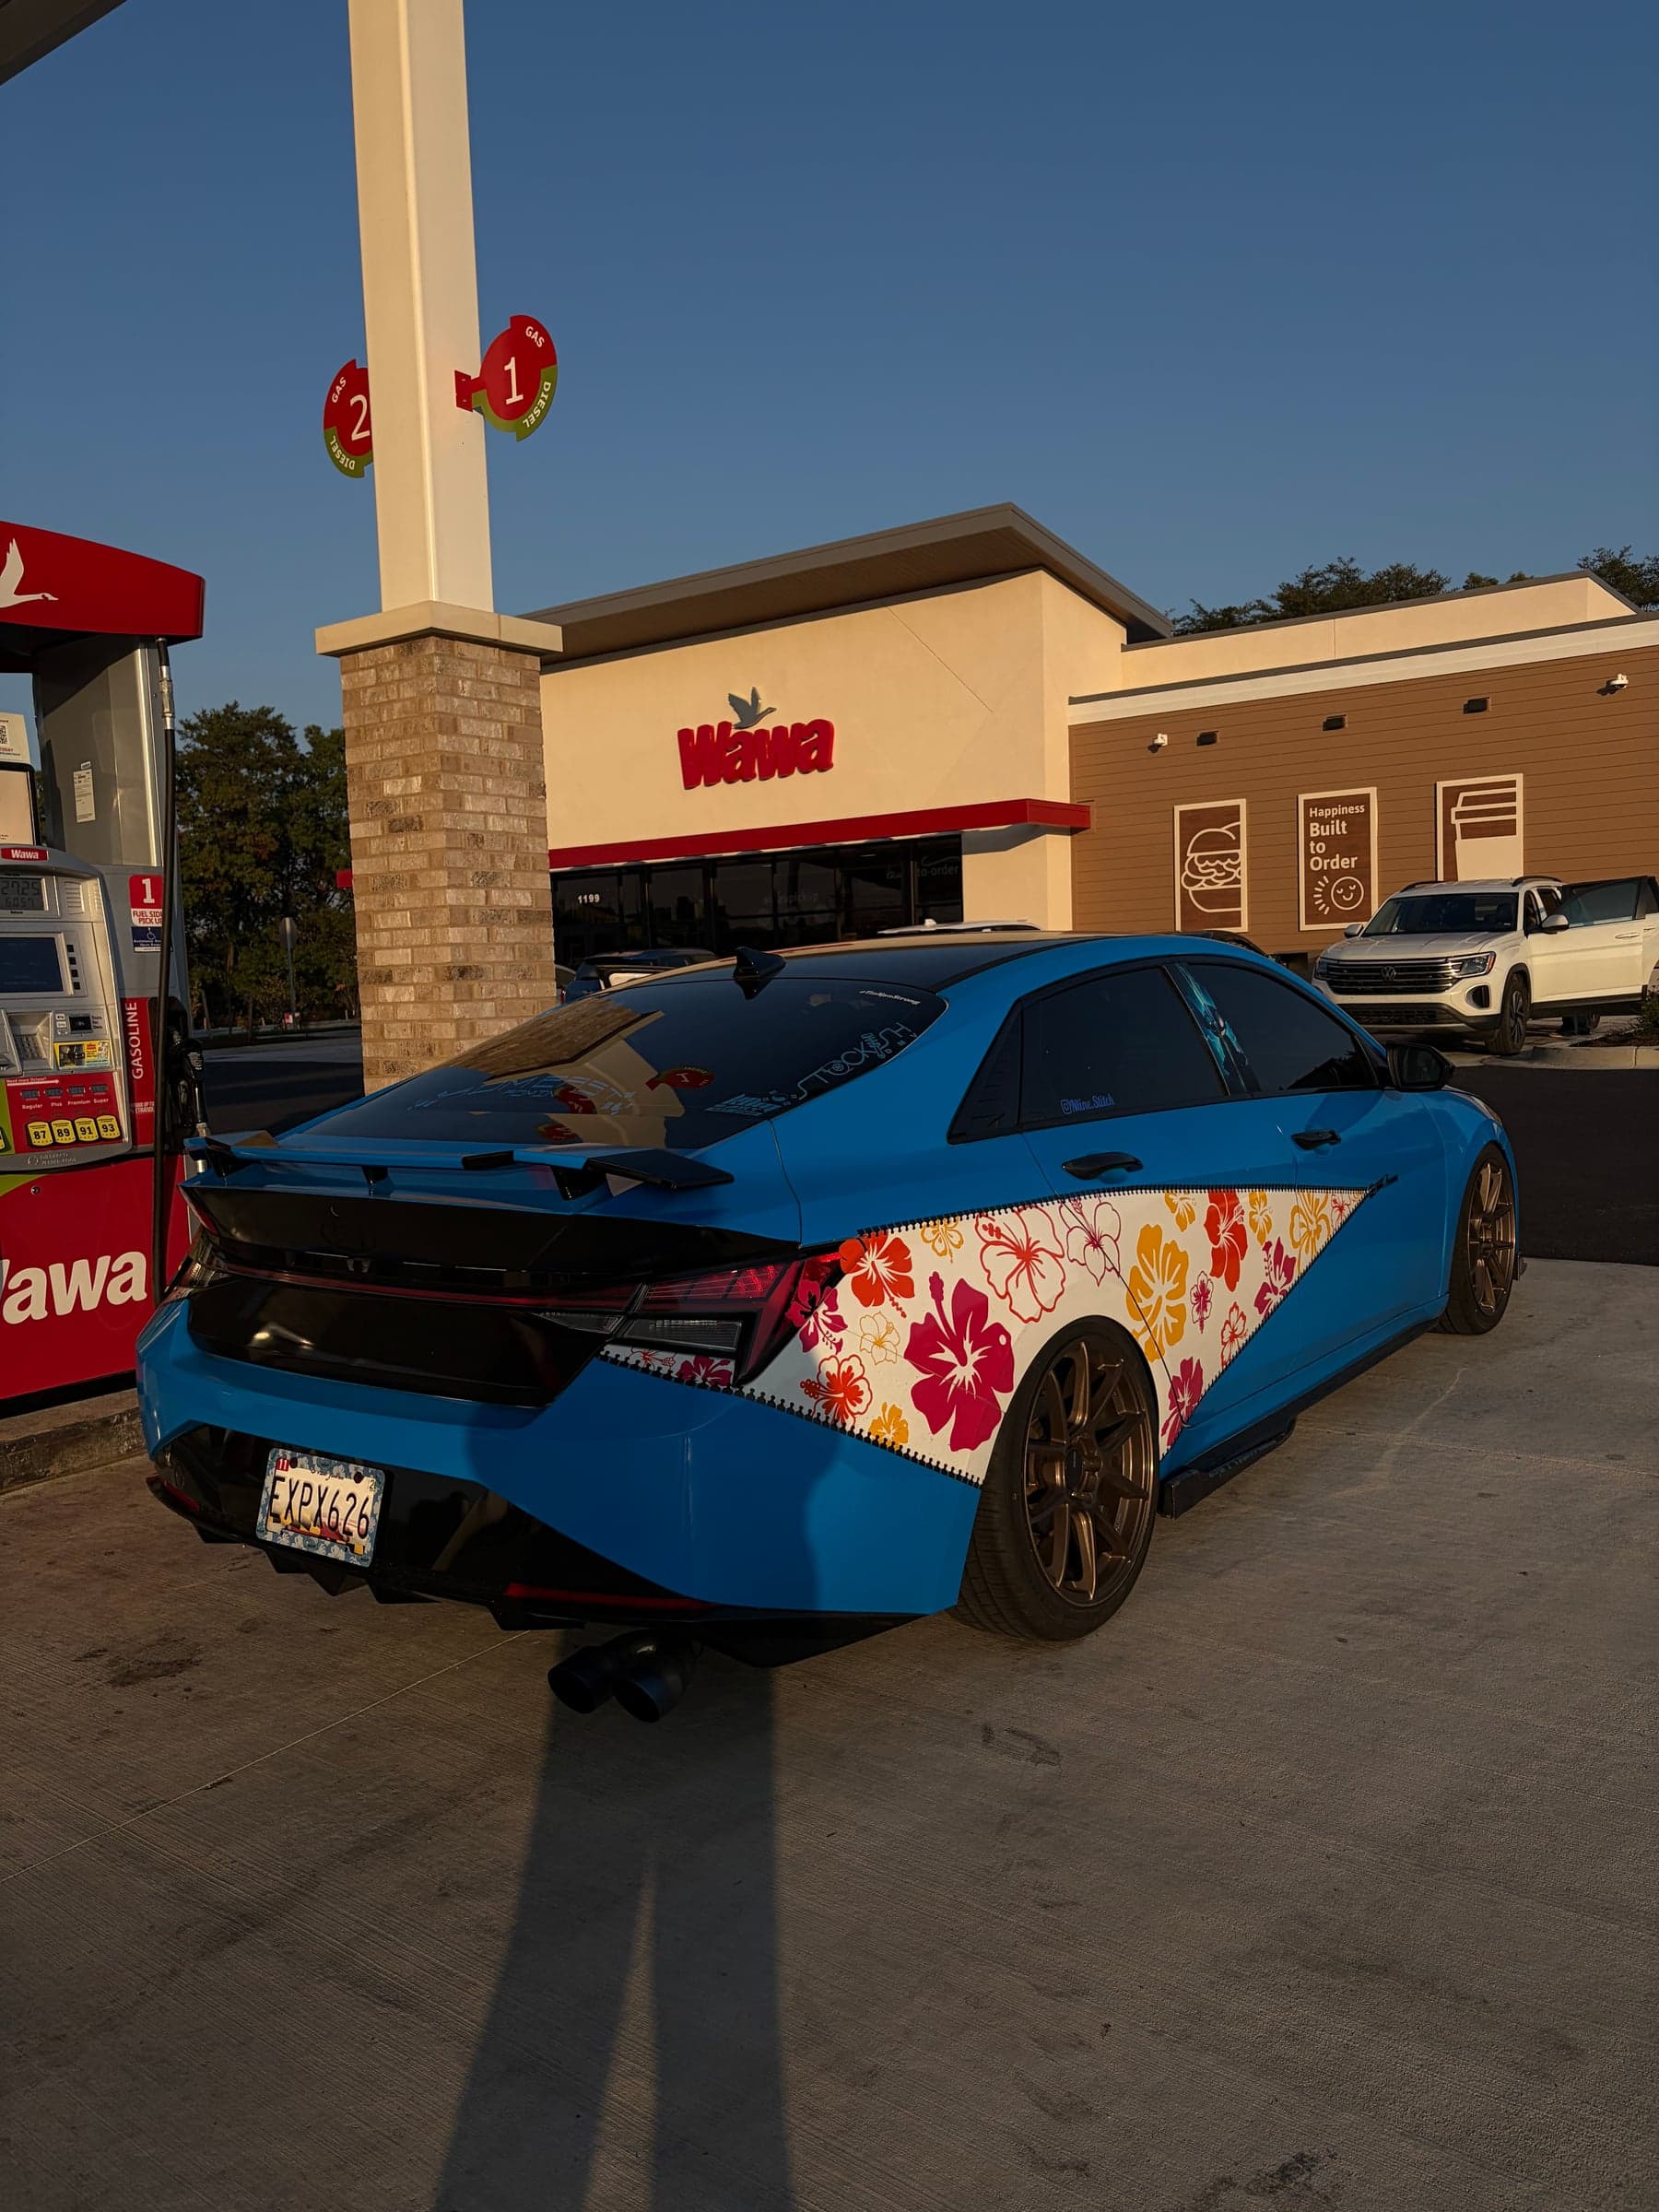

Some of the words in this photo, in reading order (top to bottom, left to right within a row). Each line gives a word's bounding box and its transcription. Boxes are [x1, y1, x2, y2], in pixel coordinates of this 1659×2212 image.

[525, 326, 545, 347] GAS
[332, 376, 347, 403] GAS
[504, 357, 524, 405] 1
[349, 394, 371, 441] 2
[522, 381, 551, 429] DIESEL
[330, 435, 356, 471] DIESEL
[677, 719, 834, 790] Wawa
[1309, 804, 1365, 818] Happiness
[1309, 819, 1347, 838] Built
[10, 849, 40, 859] Wawa
[1309, 841, 1326, 854] to
[1310, 853, 1358, 871] Order
[141, 877, 156, 904] 1
[577, 893, 600, 904] 1199
[124, 1002, 145, 1080] GASOLINE
[33, 1130, 46, 1140] 87
[56, 1128, 70, 1137] 89
[80, 1126, 93, 1135] 91
[101, 1124, 115, 1133] 93
[0, 1251, 147, 1325] awa
[269, 1476, 370, 1539] EXPX626
